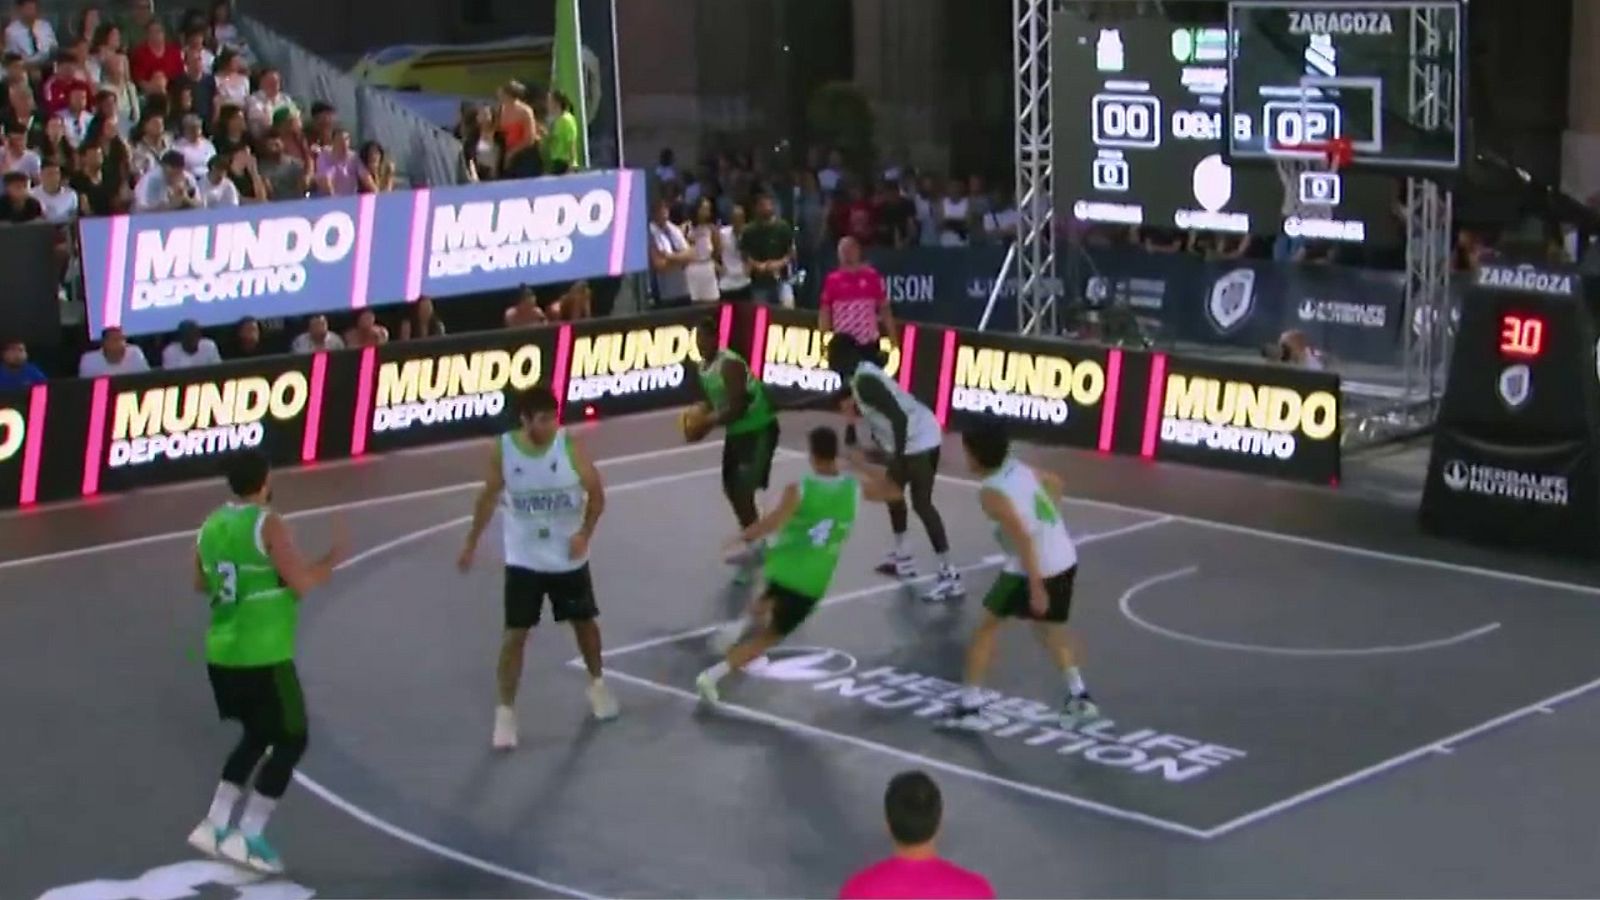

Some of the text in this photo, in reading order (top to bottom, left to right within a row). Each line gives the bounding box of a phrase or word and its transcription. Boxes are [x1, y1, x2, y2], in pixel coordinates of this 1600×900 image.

[1288, 10, 1392, 35] ZARAGOZA
[1103, 102, 1149, 138] 00
[431, 190, 614, 250] MUNDO
[137, 212, 355, 281] MUNDO
[427, 237, 573, 278] DEPORTIVO
[131, 265, 306, 310] DEPORTIVO
[1478, 266, 1571, 295] ZARAGOZA
[377, 345, 541, 406] MUNDO
[567, 363, 685, 402] DEPORTIVO
[955, 345, 1105, 406] MUNDO
[112, 371, 308, 439] MUNDO
[373, 391, 505, 432] DEPORTIVO
[952, 385, 1069, 425] DEPORTIVO
[1164, 372, 1338, 439] MUNDO
[108, 422, 264, 467] DEPORTIVO
[1160, 417, 1296, 461] DEPORTIVO
[1471, 464, 1568, 489] HERBALIFE
[808, 518, 834, 547] 4
[217, 560, 237, 603] 3
